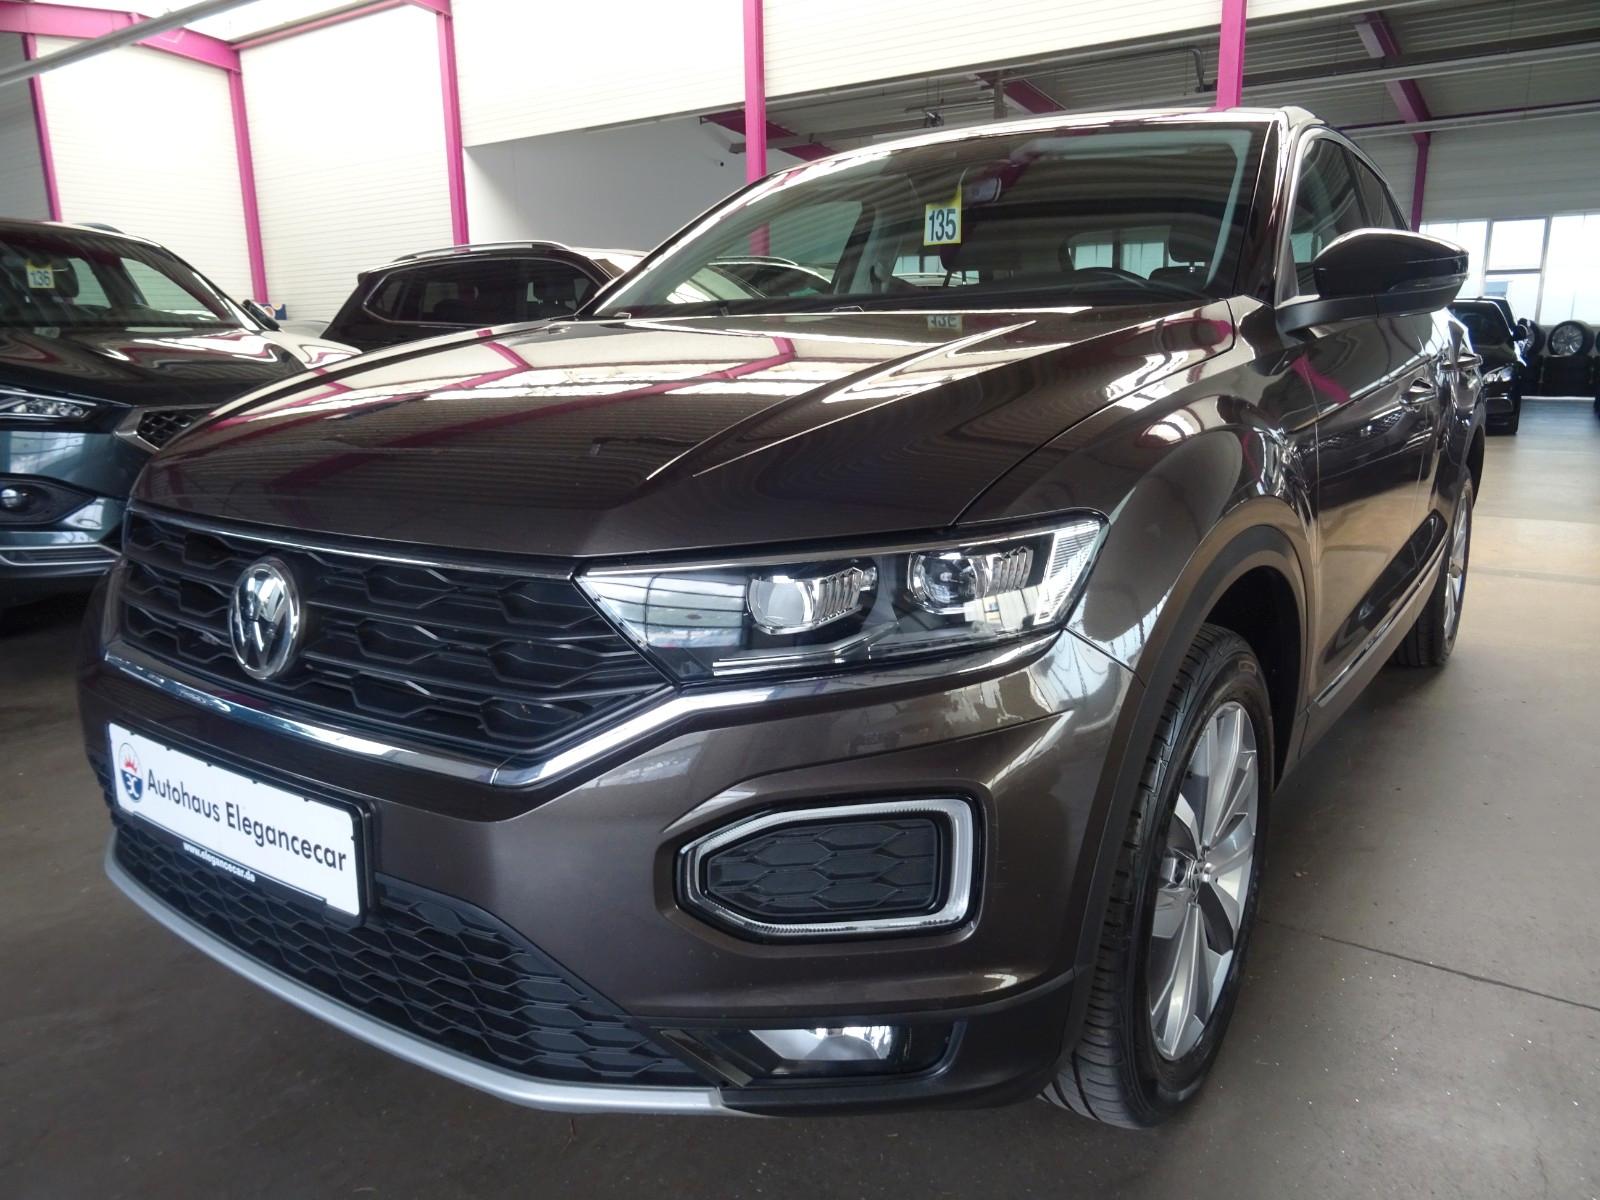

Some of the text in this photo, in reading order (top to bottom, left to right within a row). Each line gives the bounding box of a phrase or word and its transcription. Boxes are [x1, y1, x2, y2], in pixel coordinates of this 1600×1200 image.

[928, 208, 957, 242] 135
[147, 769, 220, 822] Autohaus
[226, 801, 347, 871] Elegancecar
